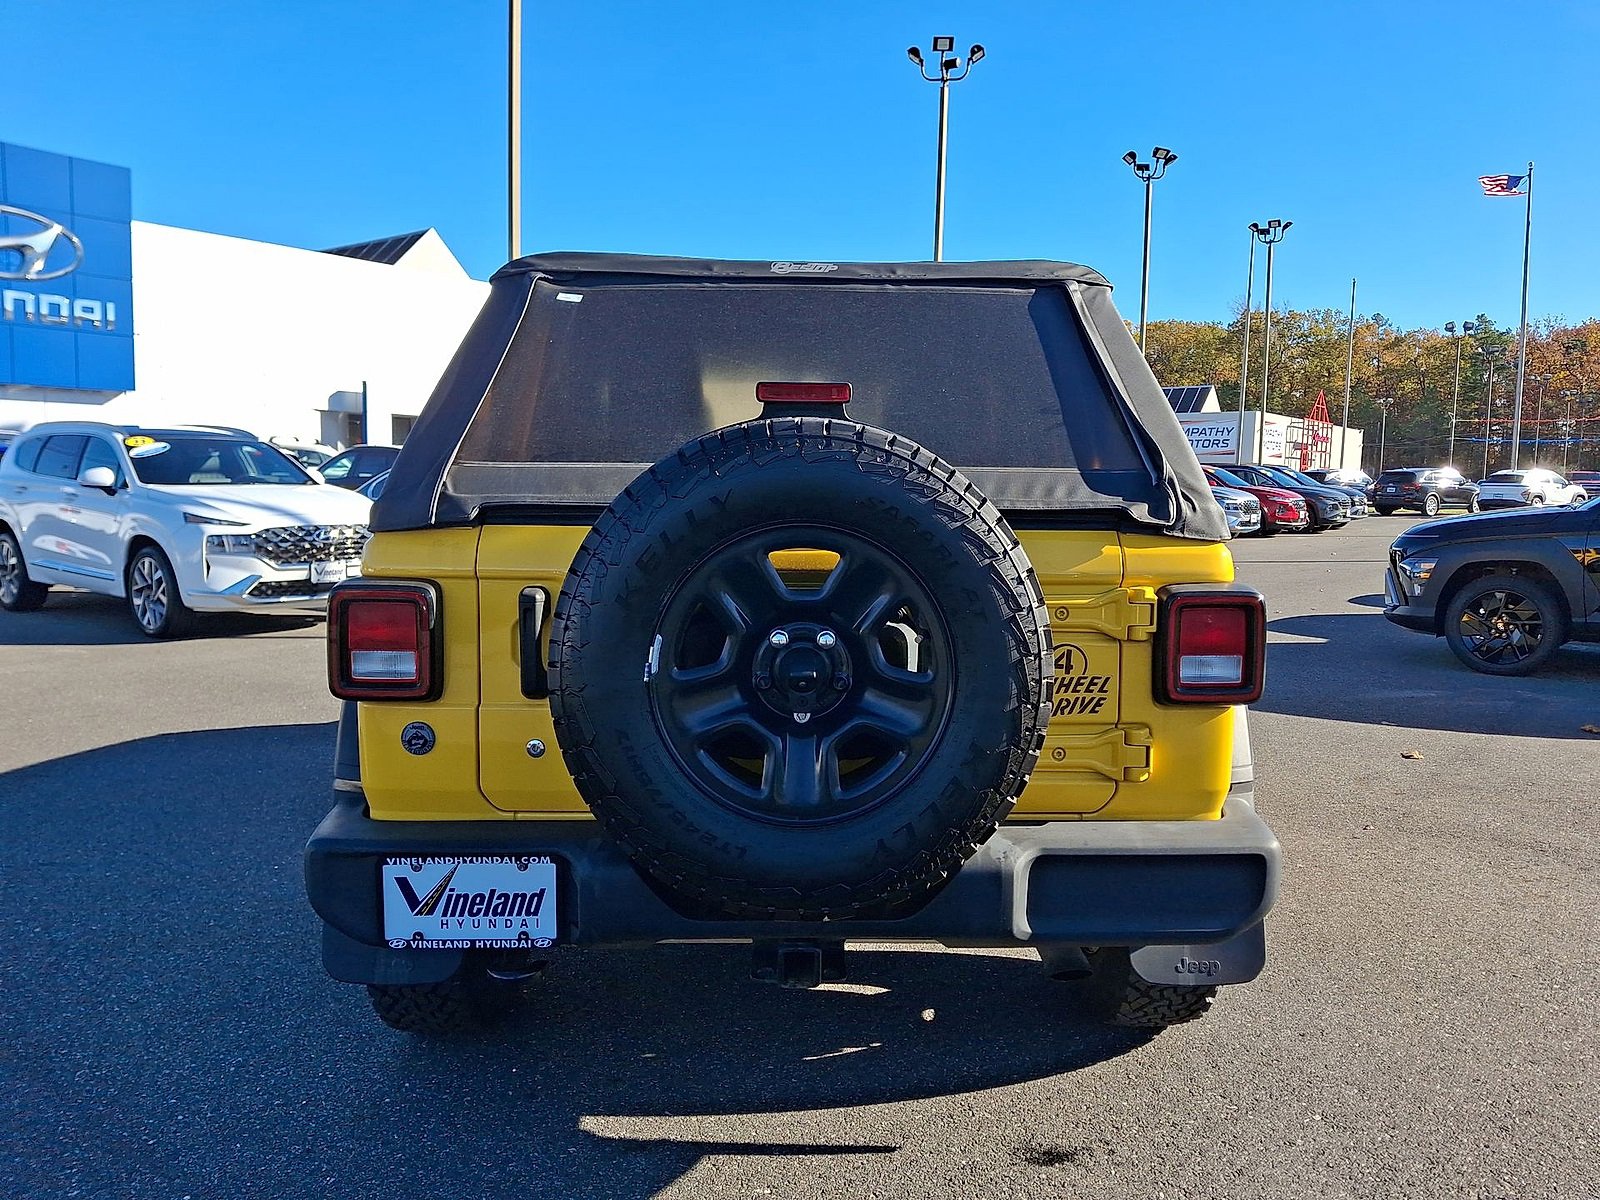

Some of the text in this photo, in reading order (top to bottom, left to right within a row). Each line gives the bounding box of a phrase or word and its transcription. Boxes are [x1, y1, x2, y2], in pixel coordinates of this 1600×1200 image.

[614, 487, 735, 606] KELLY
[1054, 649, 1074, 675] 4
[1053, 675, 1113, 695] HEEL
[1050, 696, 1108, 718] RIVE
[386, 856, 551, 866] VINELANDHYUNDAI.COM
[394, 863, 547, 918] Vineland
[441, 919, 540, 929] HYUNDAI
[410, 940, 532, 949] VINELAND HYUNDAI
[1174, 956, 1221, 977] Jeep
